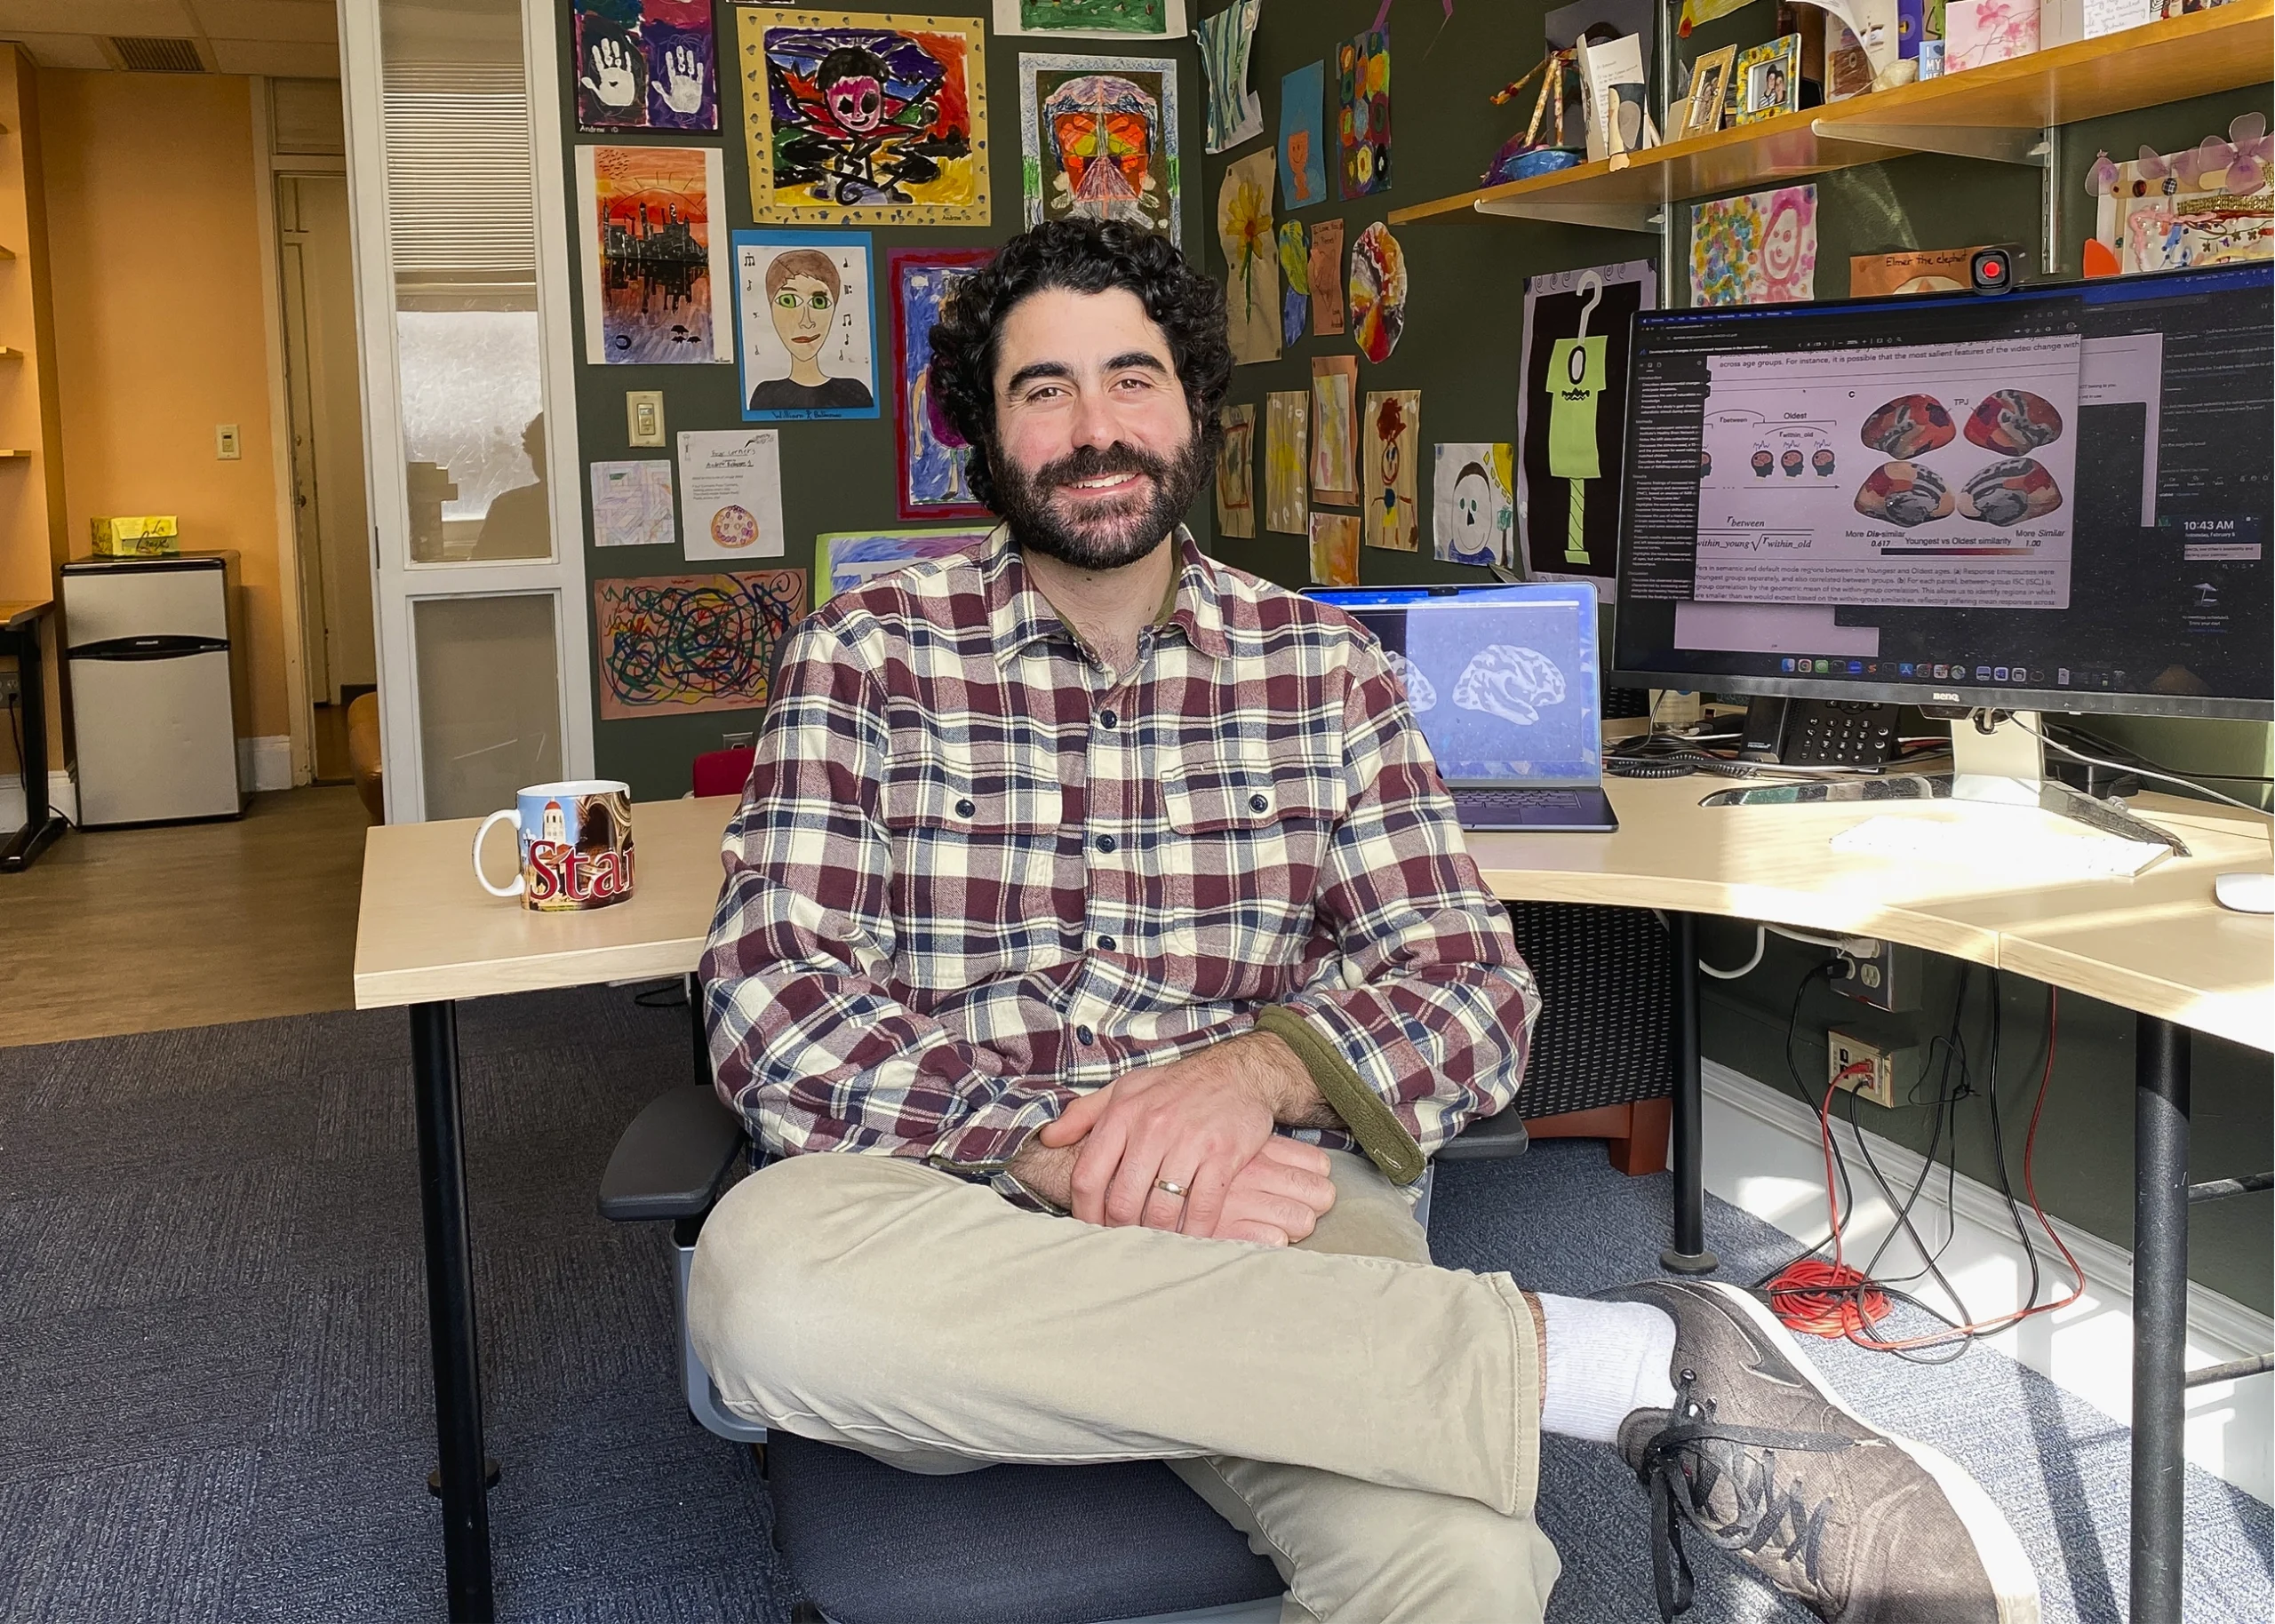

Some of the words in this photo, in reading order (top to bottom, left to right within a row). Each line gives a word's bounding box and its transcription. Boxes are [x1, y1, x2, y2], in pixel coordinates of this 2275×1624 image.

[1926, 59, 1942, 71] MY
[1886, 257, 1913, 267] Elmer
[1915, 253, 1934, 266] the
[1742, 360, 1756, 369] age
[1758, 359, 1783, 368] groups.
[1800, 356, 1831, 365] instance,
[1847, 354, 1877, 364] possible
[1928, 349, 1953, 358] salient
[1954, 347, 1984, 356] features
[1985, 346, 1995, 354] of
[2033, 343, 2062, 354] change
[2183, 521, 2214, 530] 10:43
[2215, 520, 2234, 530] AM
[1846, 529, 1864, 538] More
[1866, 529, 1906, 538] Dis-similar
[2038, 529, 2065, 537] Similar
[1904, 537, 1940, 547] Youngest
[1952, 537, 1977, 545] Oldest
[1978, 537, 2012, 547] similarity
[1960, 578, 2011, 587] between-group
[1839, 595, 1880, 604] within-group
[1917, 596, 1949, 605] reflecting
[1932, 692, 1960, 703] BenQ
